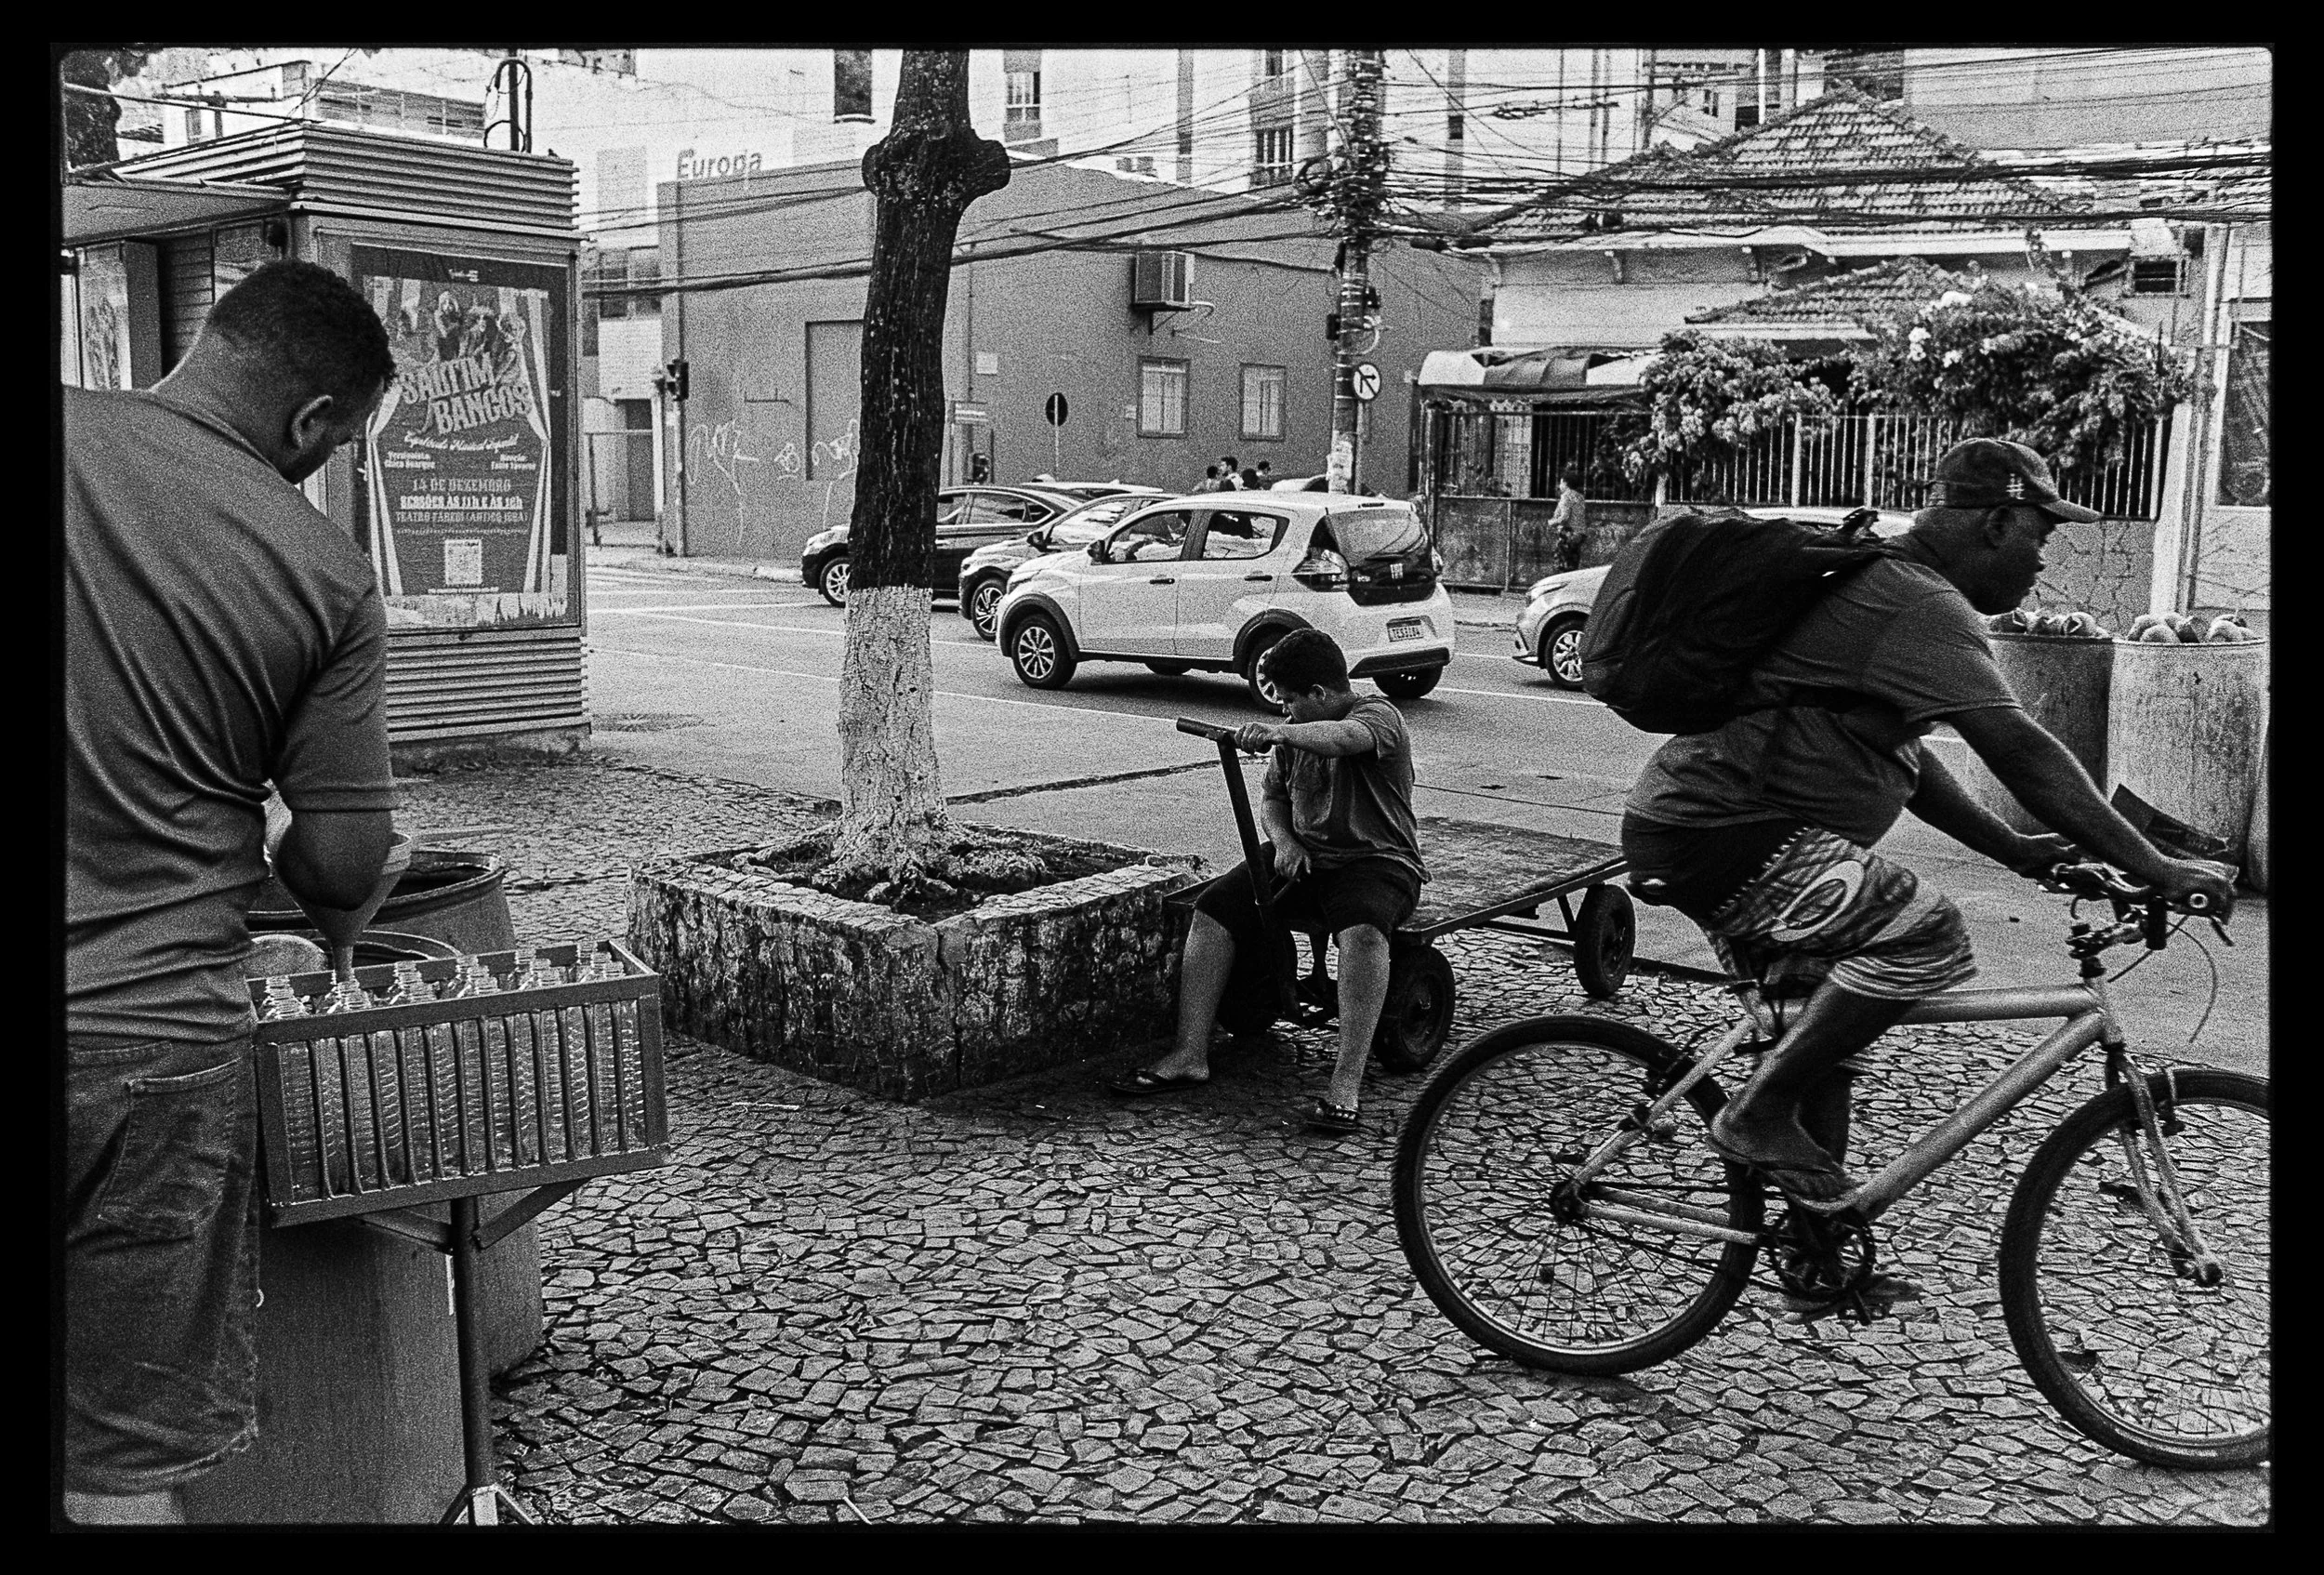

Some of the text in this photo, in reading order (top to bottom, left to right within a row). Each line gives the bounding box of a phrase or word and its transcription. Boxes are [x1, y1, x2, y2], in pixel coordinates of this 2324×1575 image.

[677, 149, 761, 179] Europa
[434, 382, 533, 435] BANCOS
[413, 478, 511, 493] 14 DE DEZEMBRO
[400, 494, 444, 509] SESSÕES
[395, 511, 430, 523] TEATRO
